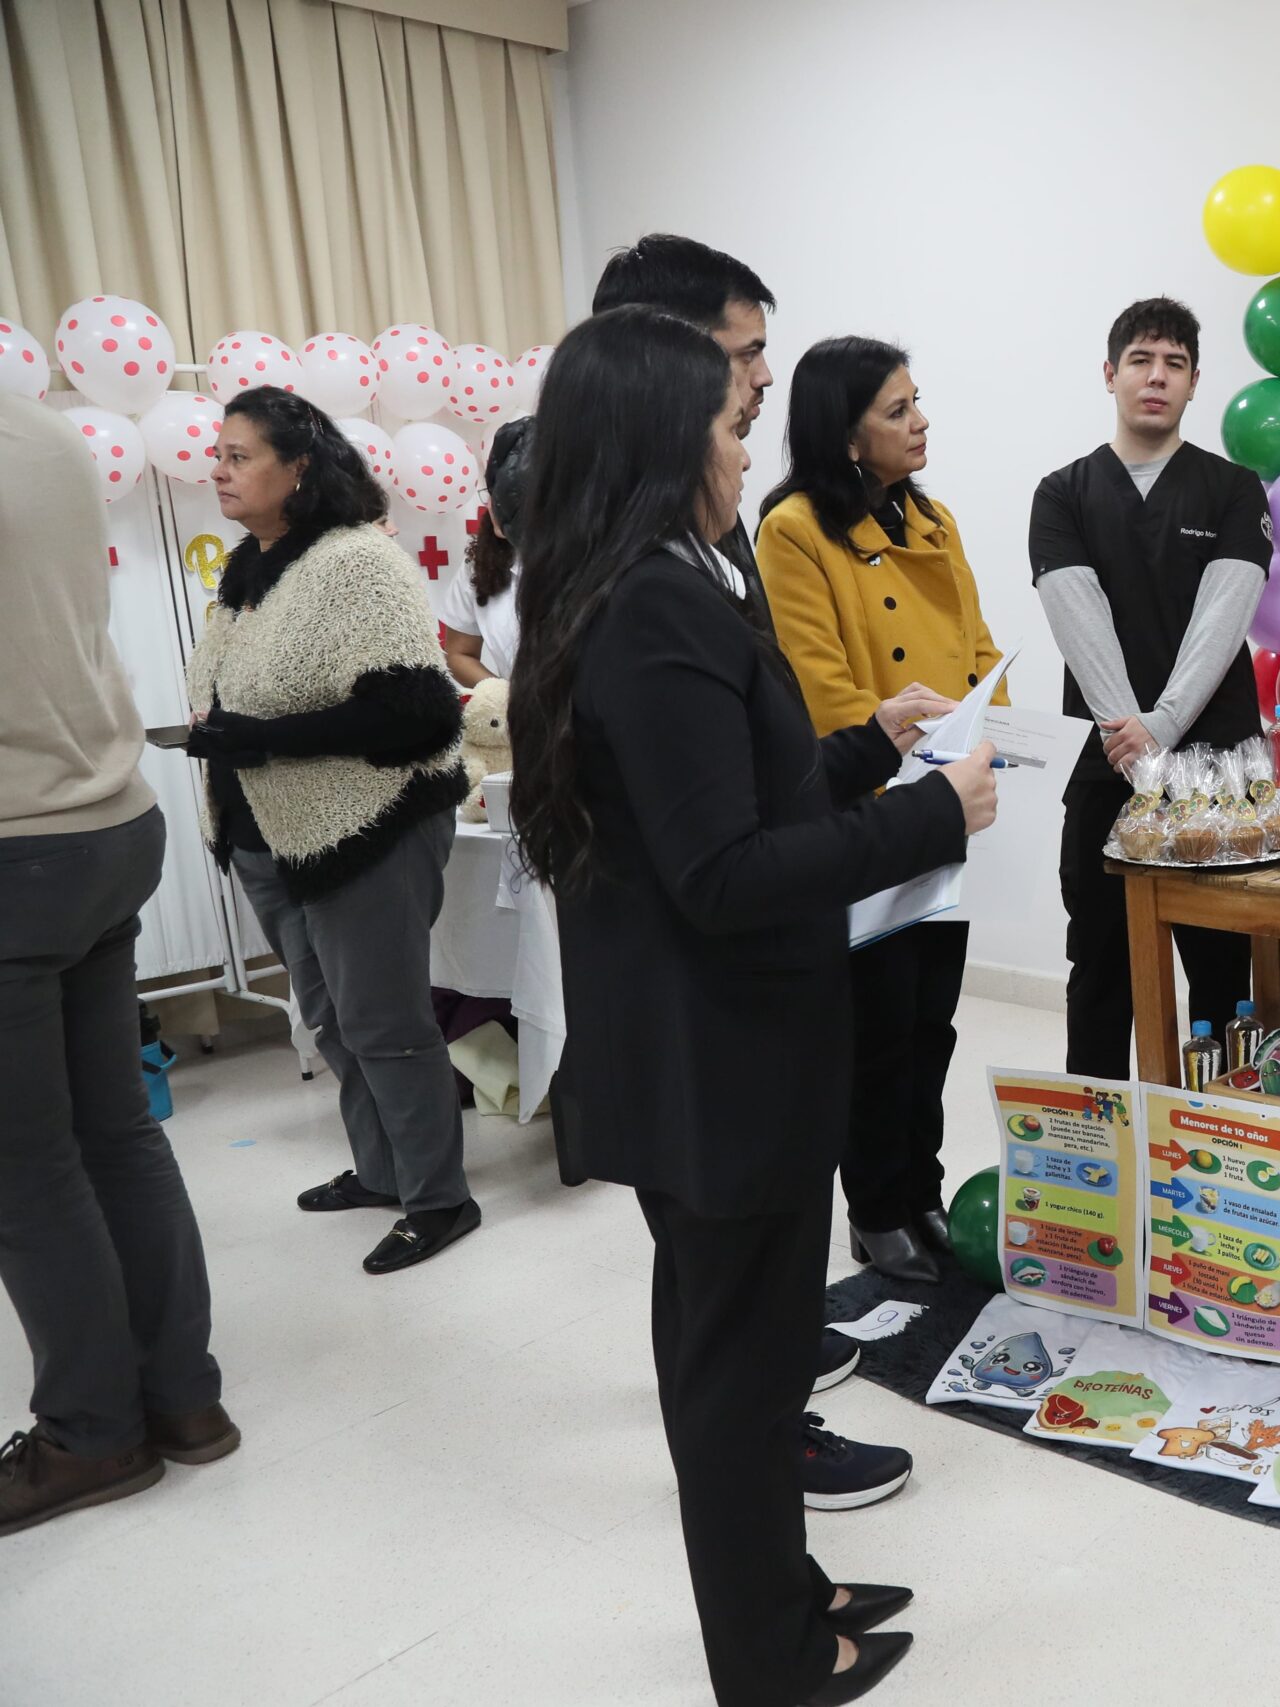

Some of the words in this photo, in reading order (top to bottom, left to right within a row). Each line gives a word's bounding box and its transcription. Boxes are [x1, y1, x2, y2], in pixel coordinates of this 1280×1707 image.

[1180, 527, 1205, 537] Rodrigo
[1041, 1106, 1069, 1117] OPCIÓN
[1054, 1118, 1072, 1127] frutas
[1080, 1122, 1106, 1132] estación
[1180, 1115, 1219, 1132] Menores
[1220, 1124, 1233, 1135] de
[1234, 1127, 1245, 1137] 10
[1246, 1130, 1269, 1143] años
[1082, 1130, 1106, 1140] banana,
[1211, 1137, 1239, 1149] OPCIÓN
[1050, 1156, 1063, 1164] taza
[1161, 1149, 1182, 1160] LUNES
[1046, 1163, 1061, 1171] leche
[1227, 1156, 1246, 1167] huevo
[1224, 1164, 1239, 1173] duro
[1239, 1167, 1244, 1175] y
[1162, 1187, 1186, 1199] MARTES
[1049, 1203, 1067, 1212] yogur
[1067, 1205, 1082, 1214] chico
[1223, 1206, 1231, 1214] de
[1231, 1207, 1249, 1219] frutas
[1249, 1213, 1258, 1221] sin
[1227, 1200, 1242, 1209] vaso
[1242, 1203, 1250, 1211] de
[1251, 1206, 1278, 1218] ensalada
[1222, 1233, 1235, 1242] taza
[1234, 1236, 1243, 1245] de
[1219, 1241, 1235, 1251] leche
[1162, 1263, 1184, 1275] JUEVES
[1207, 1263, 1216, 1272] de
[1090, 1271, 1098, 1279] de
[1087, 1278, 1096, 1286] de
[1158, 1300, 1184, 1314] VIERNES
[1236, 1312, 1267, 1326] triángulo
[1267, 1318, 1277, 1326] de
[1266, 1324, 1276, 1333] de
[1235, 1335, 1246, 1343] sin
[1073, 1379, 1154, 1401] PROTEÍNAS
